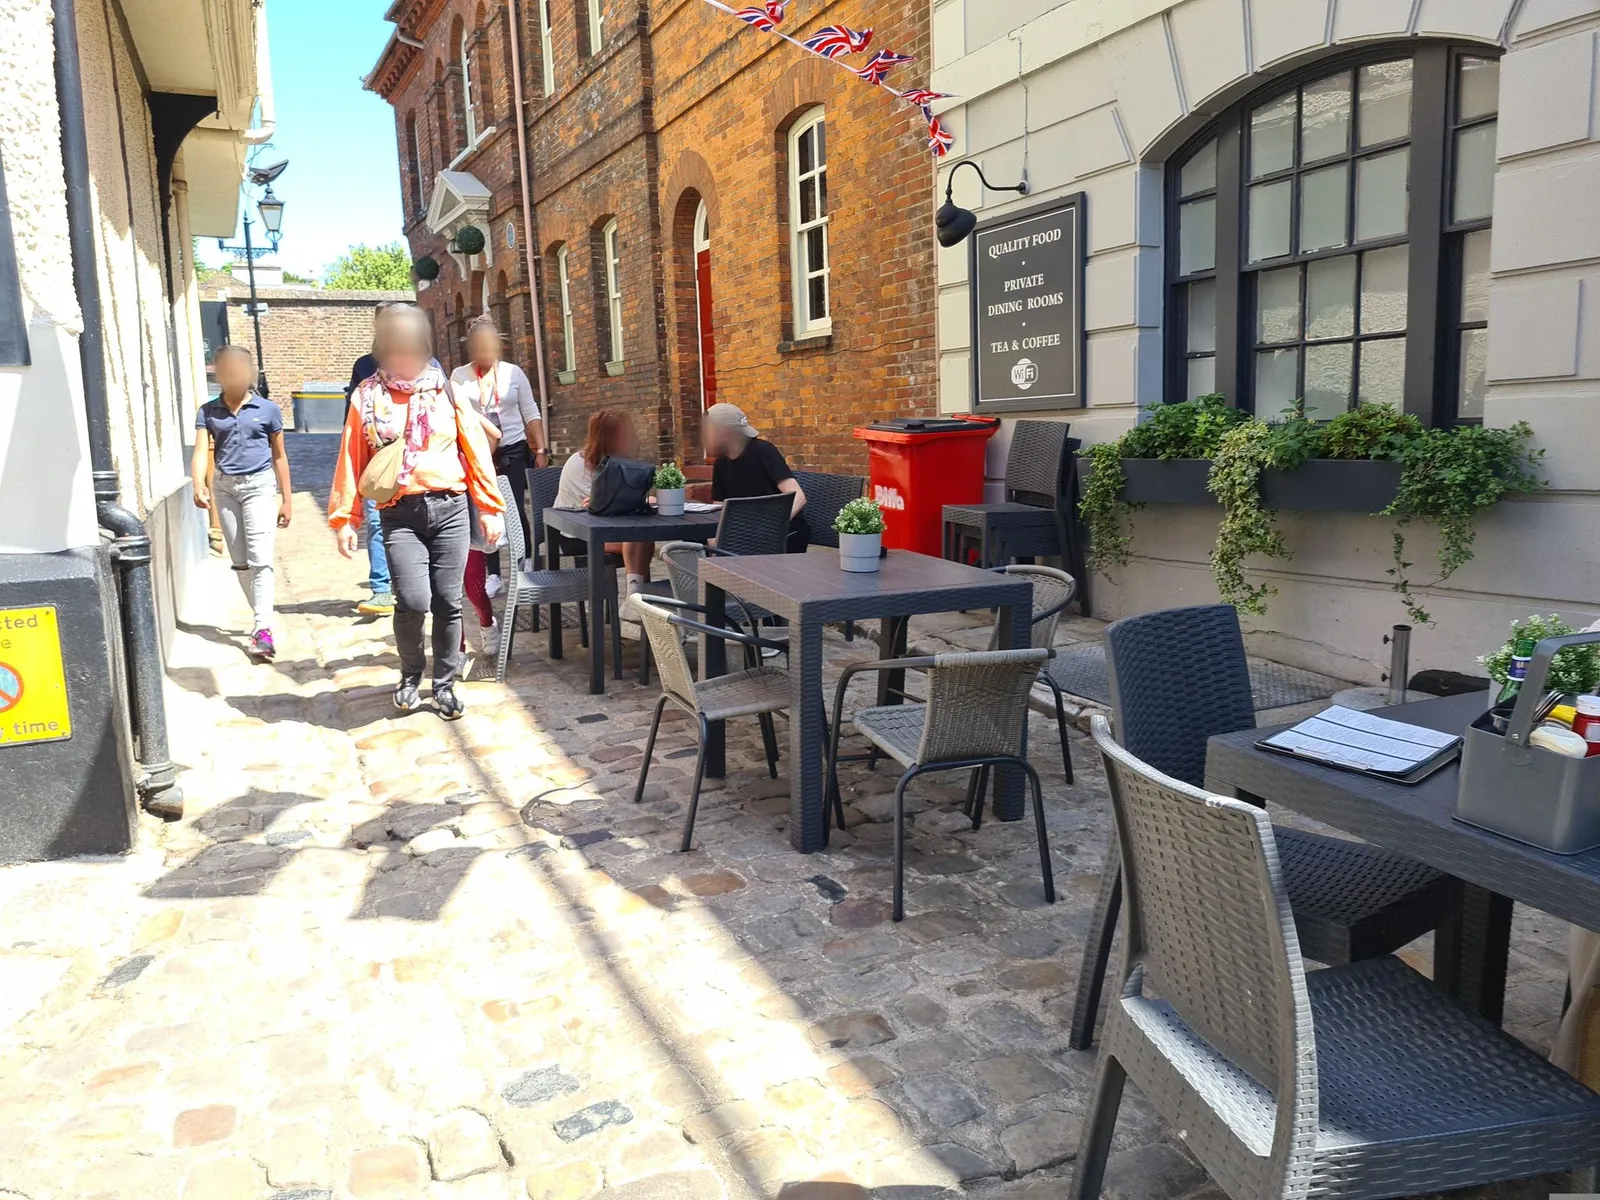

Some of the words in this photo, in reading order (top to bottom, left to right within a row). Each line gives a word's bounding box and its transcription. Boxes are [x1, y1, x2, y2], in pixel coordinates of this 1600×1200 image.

[988, 236, 1031, 259] QUALITY
[1032, 228, 1062, 247] FOOD
[1003, 273, 1045, 292] PRIVATE
[987, 299, 1023, 317] DINING
[1027, 292, 1064, 310] ROOMS
[990, 341, 1010, 354] TEA
[1011, 339, 1020, 351] &
[1022, 333, 1061, 350] COFFEE
[13, 720, 59, 735] time
